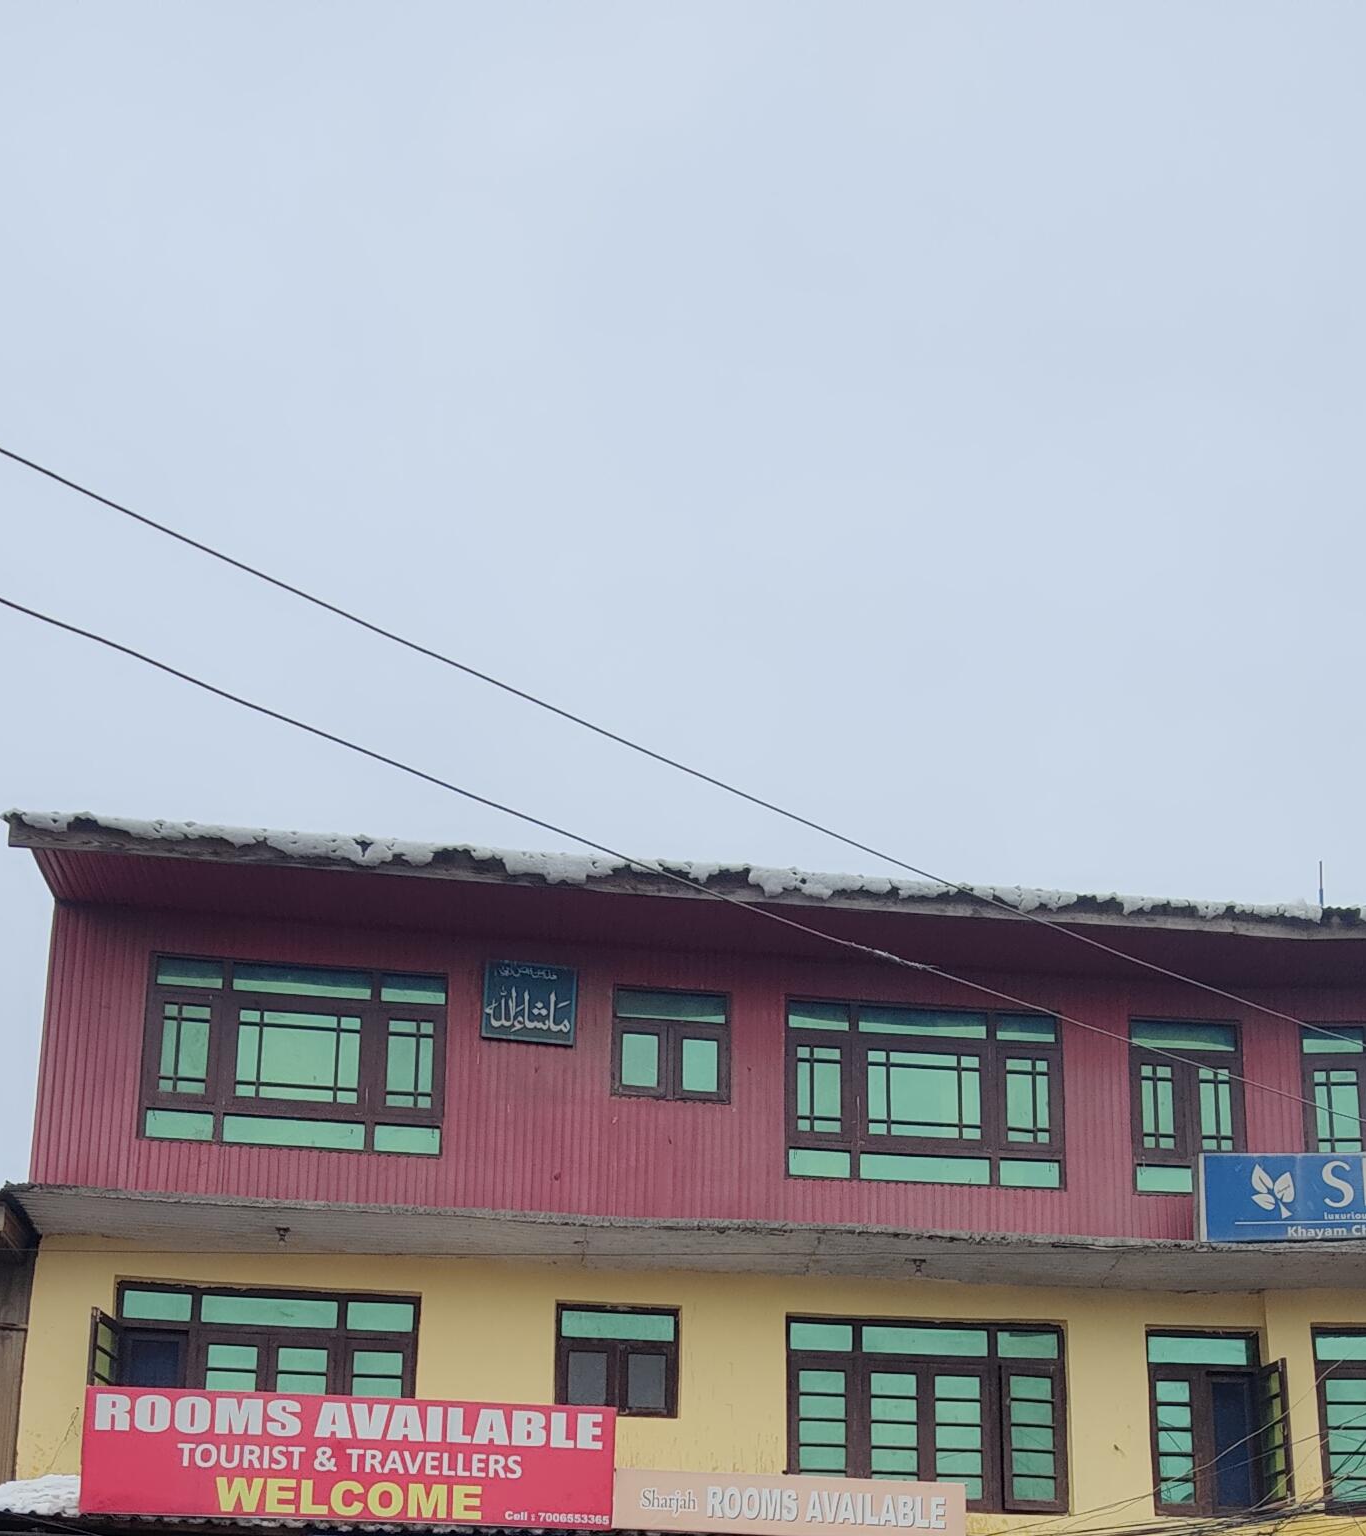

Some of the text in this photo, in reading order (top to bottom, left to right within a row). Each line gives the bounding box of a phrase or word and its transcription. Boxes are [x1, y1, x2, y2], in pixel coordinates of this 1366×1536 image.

[1287, 1225, 1347, 1239] Khayam
[94, 1393, 604, 1450] ROOMS AVAILABLE
[177, 1442, 523, 1479] TOURIST & TRAVELLERS
[216, 1476, 483, 1521] WELCOME
[504, 1510, 528, 1521] Cell
[538, 1511, 610, 1525] 7006553365
[640, 1486, 946, 1530] Sharjah ROOMS AVAILABLE
